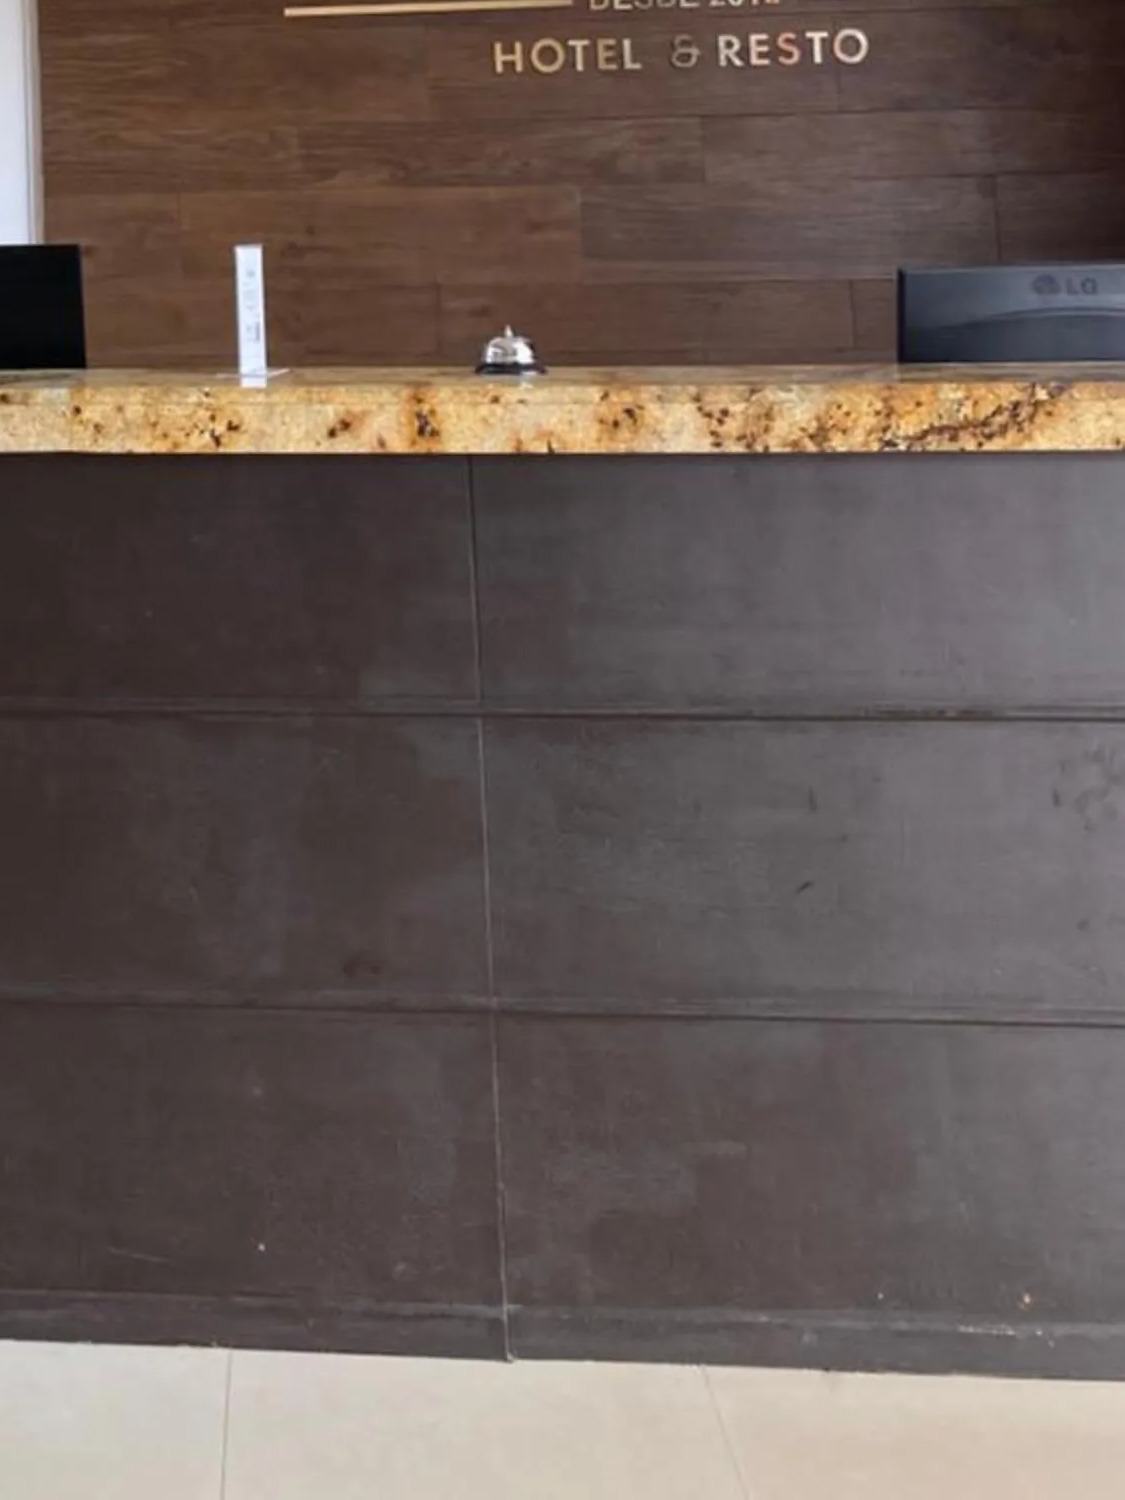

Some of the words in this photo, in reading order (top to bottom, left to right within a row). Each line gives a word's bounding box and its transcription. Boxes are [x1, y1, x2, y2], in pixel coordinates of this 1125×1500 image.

[494, 39, 642, 74] HOTEL
[671, 37, 700, 67] &
[717, 29, 869, 67] RESTO
